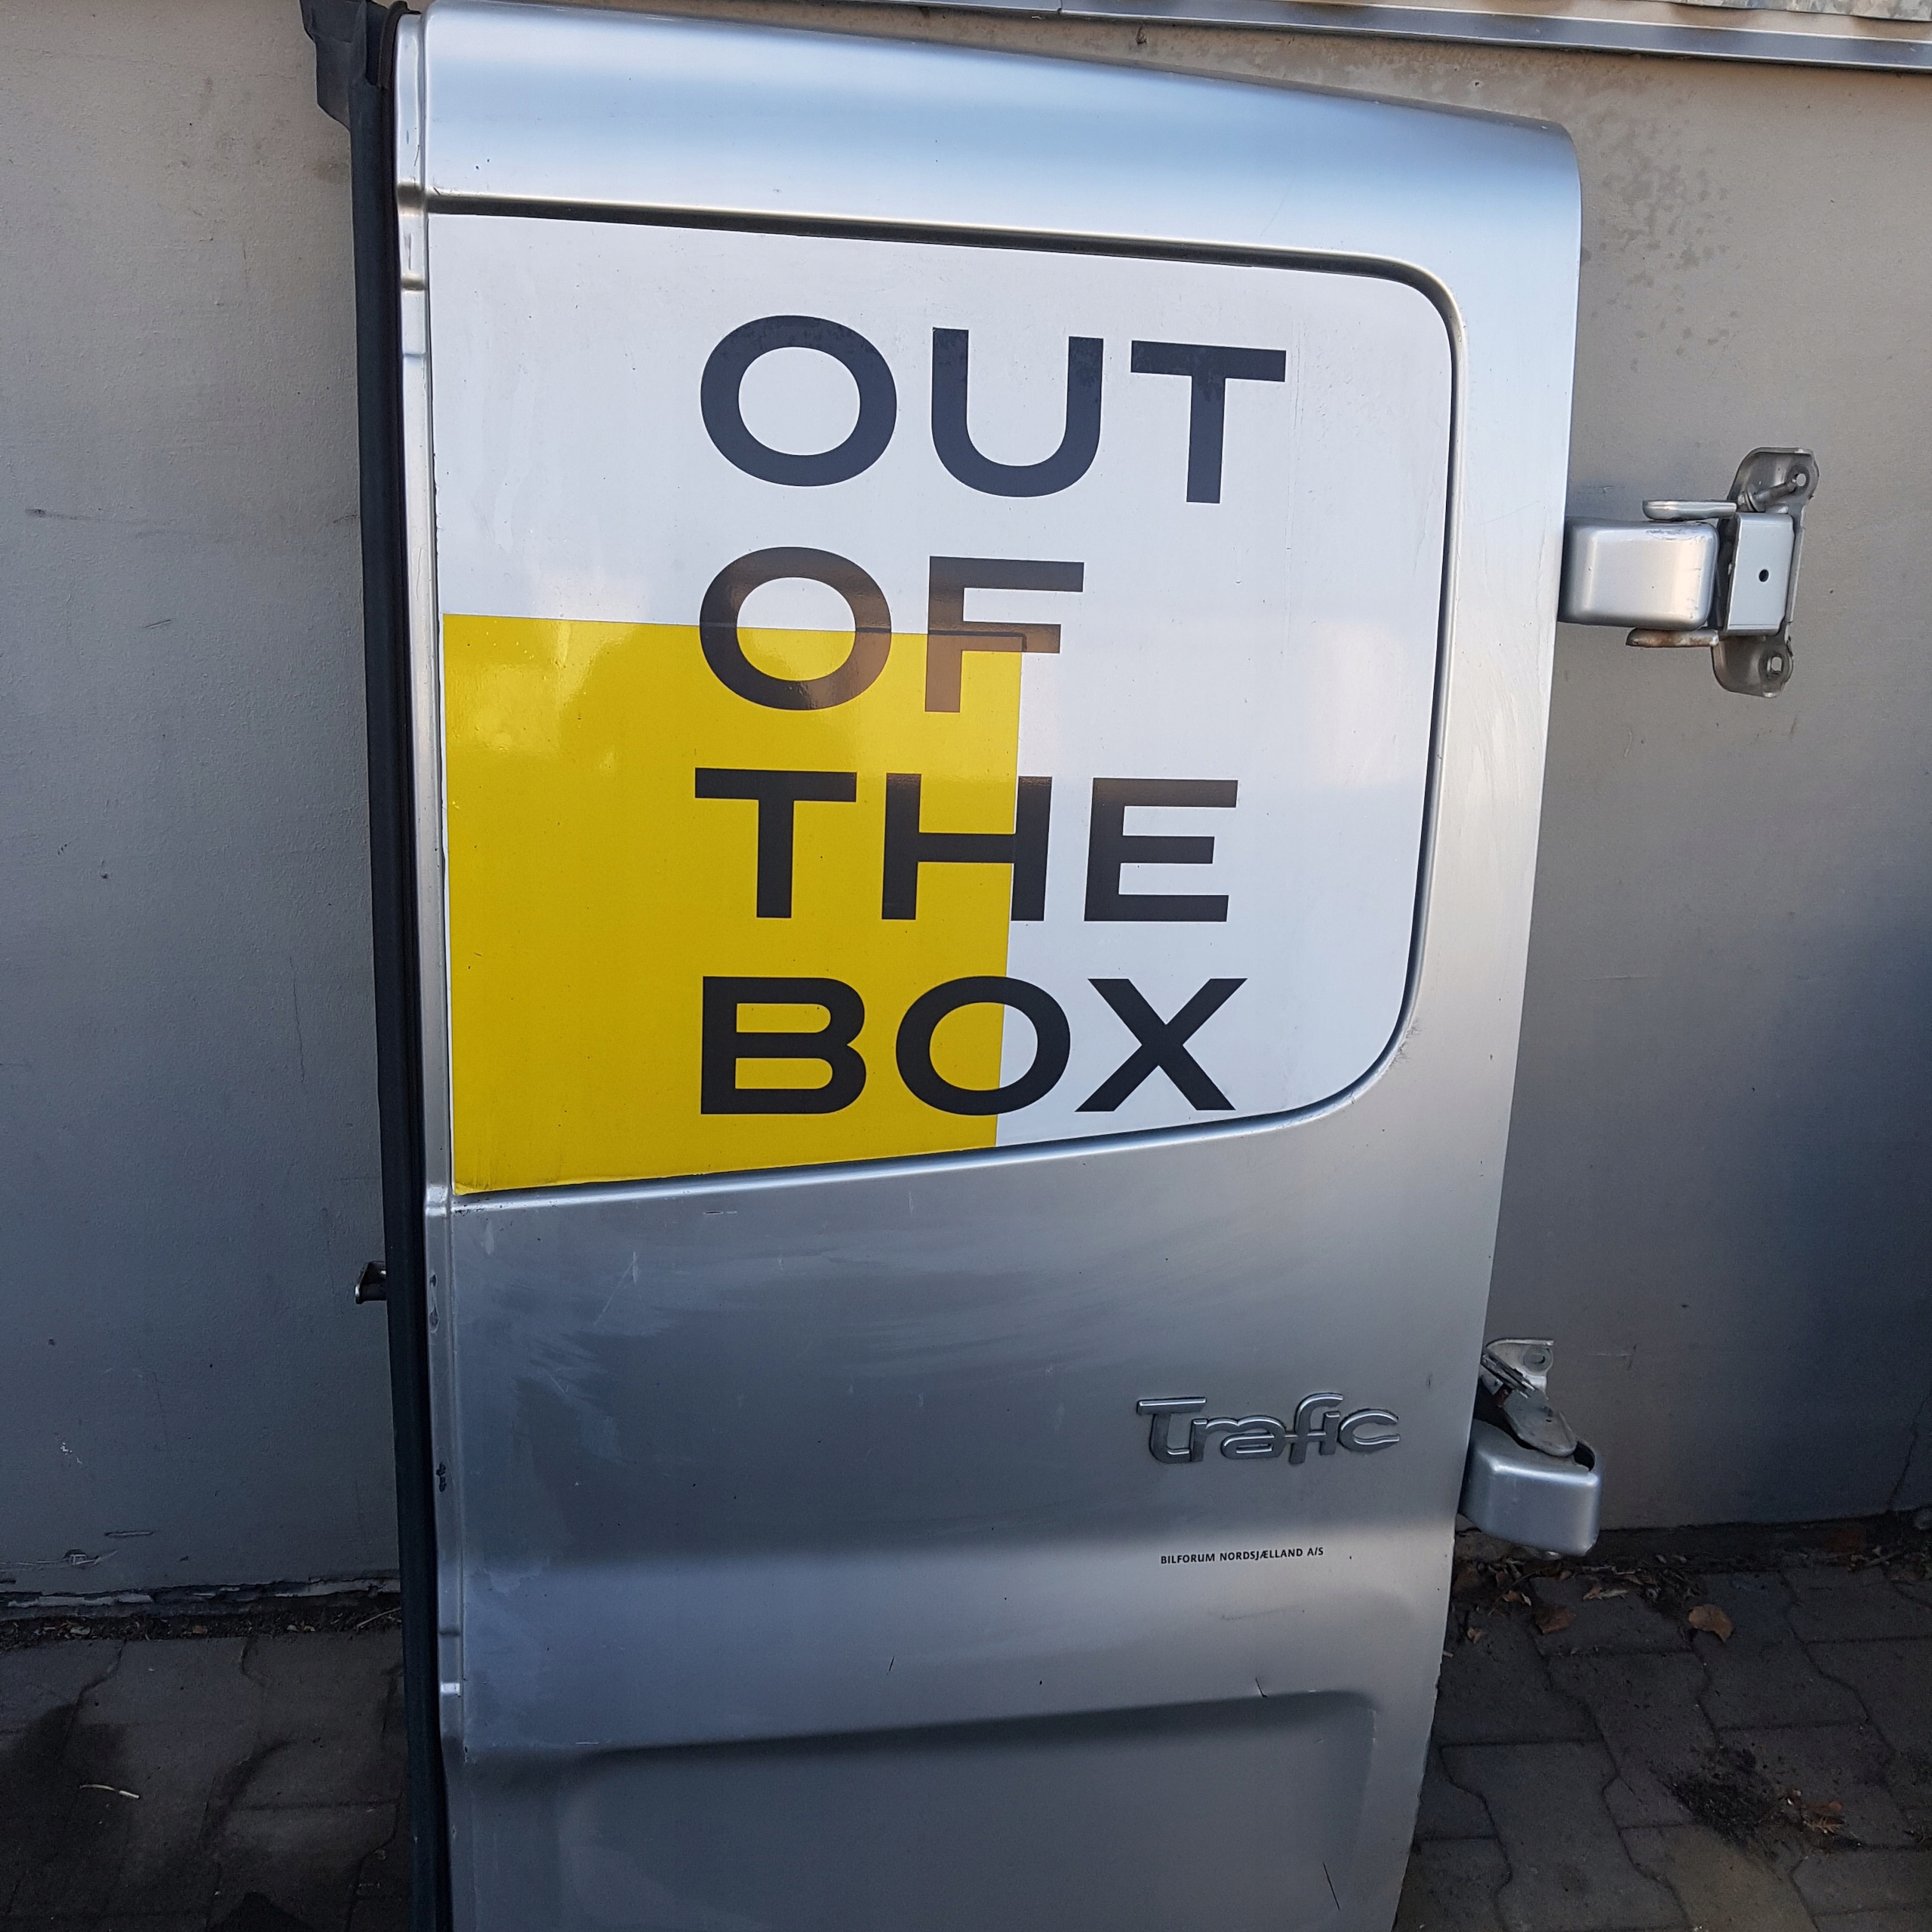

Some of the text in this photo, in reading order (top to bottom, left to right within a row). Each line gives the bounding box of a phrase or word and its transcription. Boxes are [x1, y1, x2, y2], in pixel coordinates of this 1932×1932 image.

[700, 315, 1285, 504] OUT
[700, 547, 1084, 713] OF
[695, 768, 1238, 921] THE
[701, 976, 1247, 1115] BOX
[1137, 1392, 1401, 1465] Trafic
[1161, 1546, 1324, 1564] BILFORUM NORDSJÆLLAND A/S
